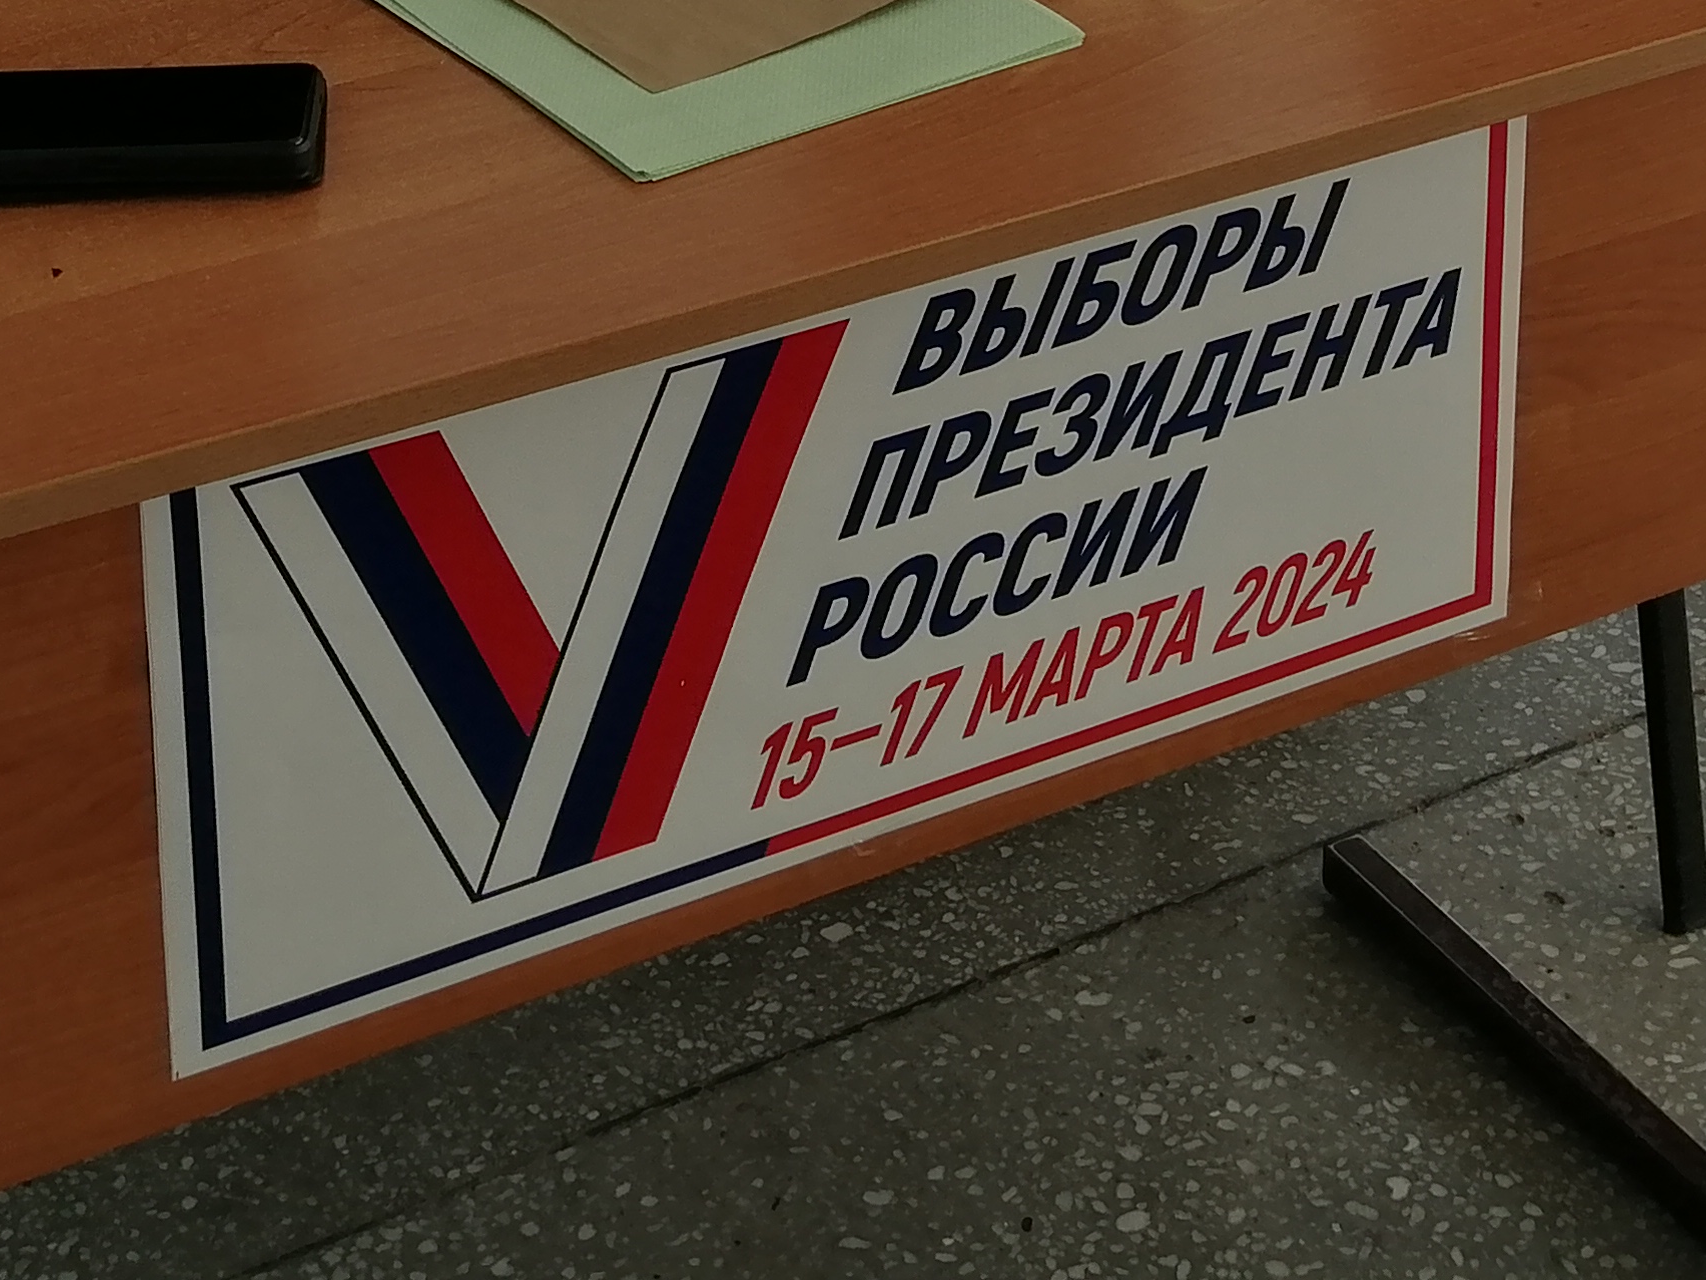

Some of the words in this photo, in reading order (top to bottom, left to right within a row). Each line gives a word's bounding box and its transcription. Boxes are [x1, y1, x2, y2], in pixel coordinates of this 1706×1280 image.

[892, 178, 1351, 397] ВЫБОРЫ
[839, 268, 1463, 541] ПРЕЗИДЕНТА
[787, 467, 1206, 688] РОССИИ
[962, 588, 1204, 738] МАРТА
[1214, 529, 1376, 655] 2024
